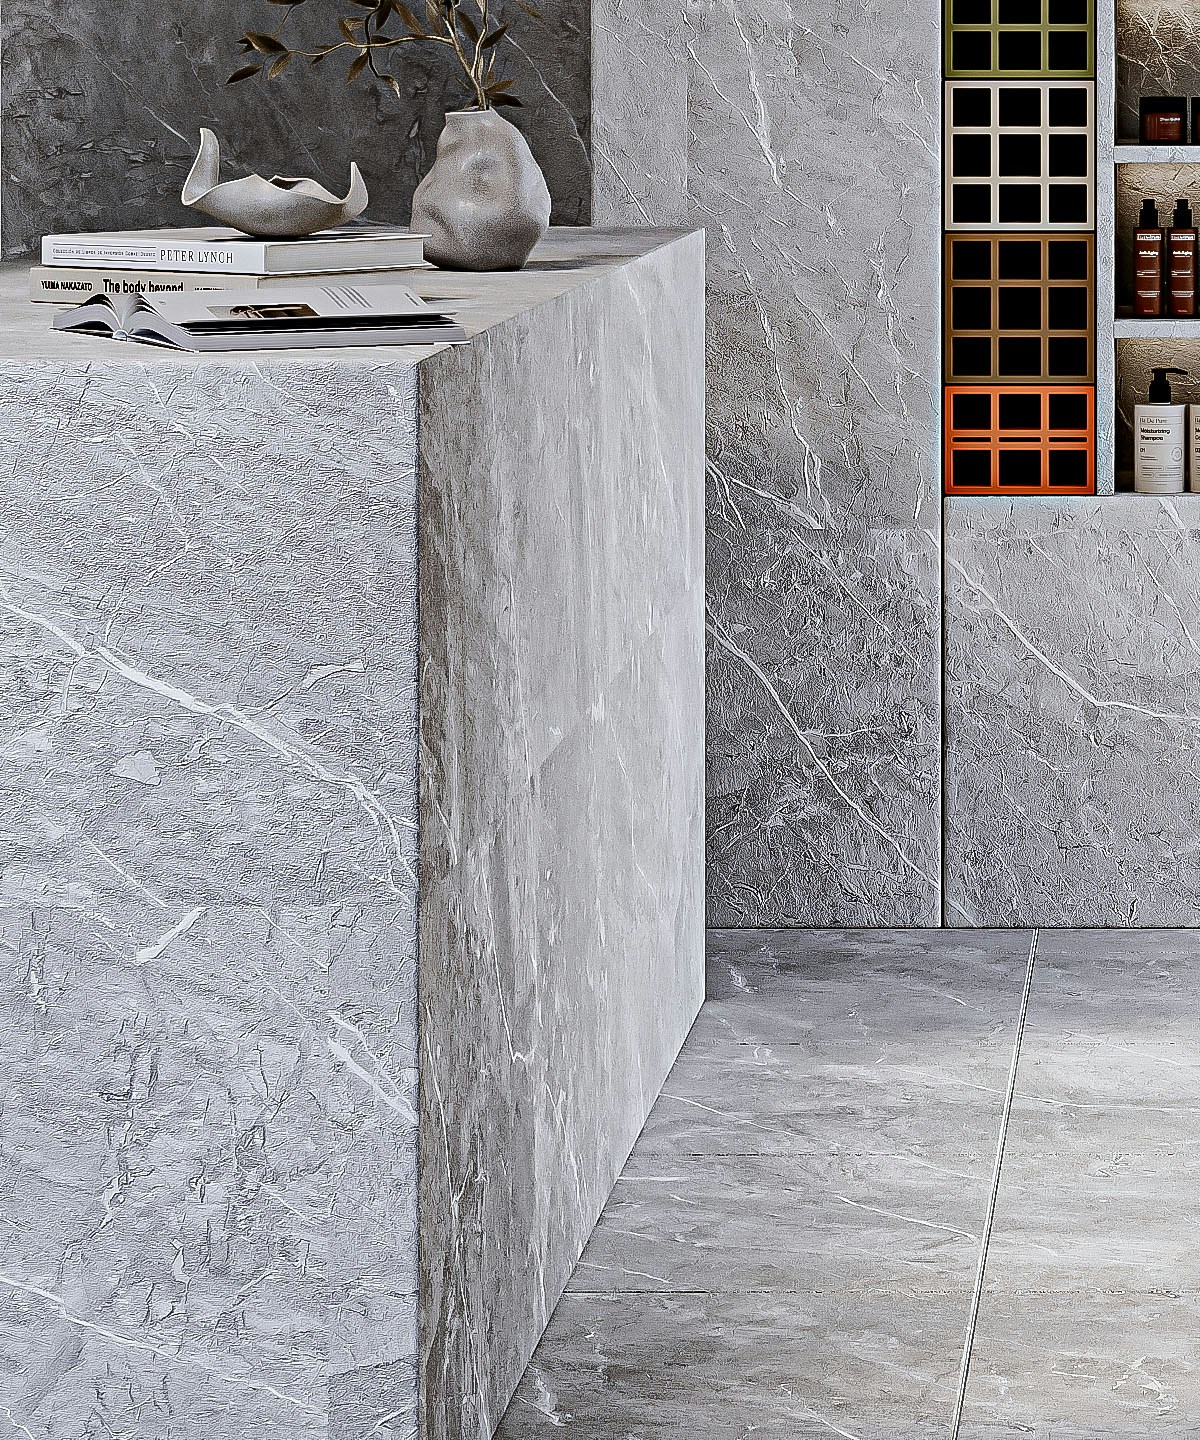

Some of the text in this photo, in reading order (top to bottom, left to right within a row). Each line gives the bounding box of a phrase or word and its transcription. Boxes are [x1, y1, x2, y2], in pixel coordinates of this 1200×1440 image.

[160, 249, 233, 264] PETER LYNCH
[60, 281, 93, 291] NAKAZATO
[103, 279, 120, 293] The
[122, 279, 145, 293] body
